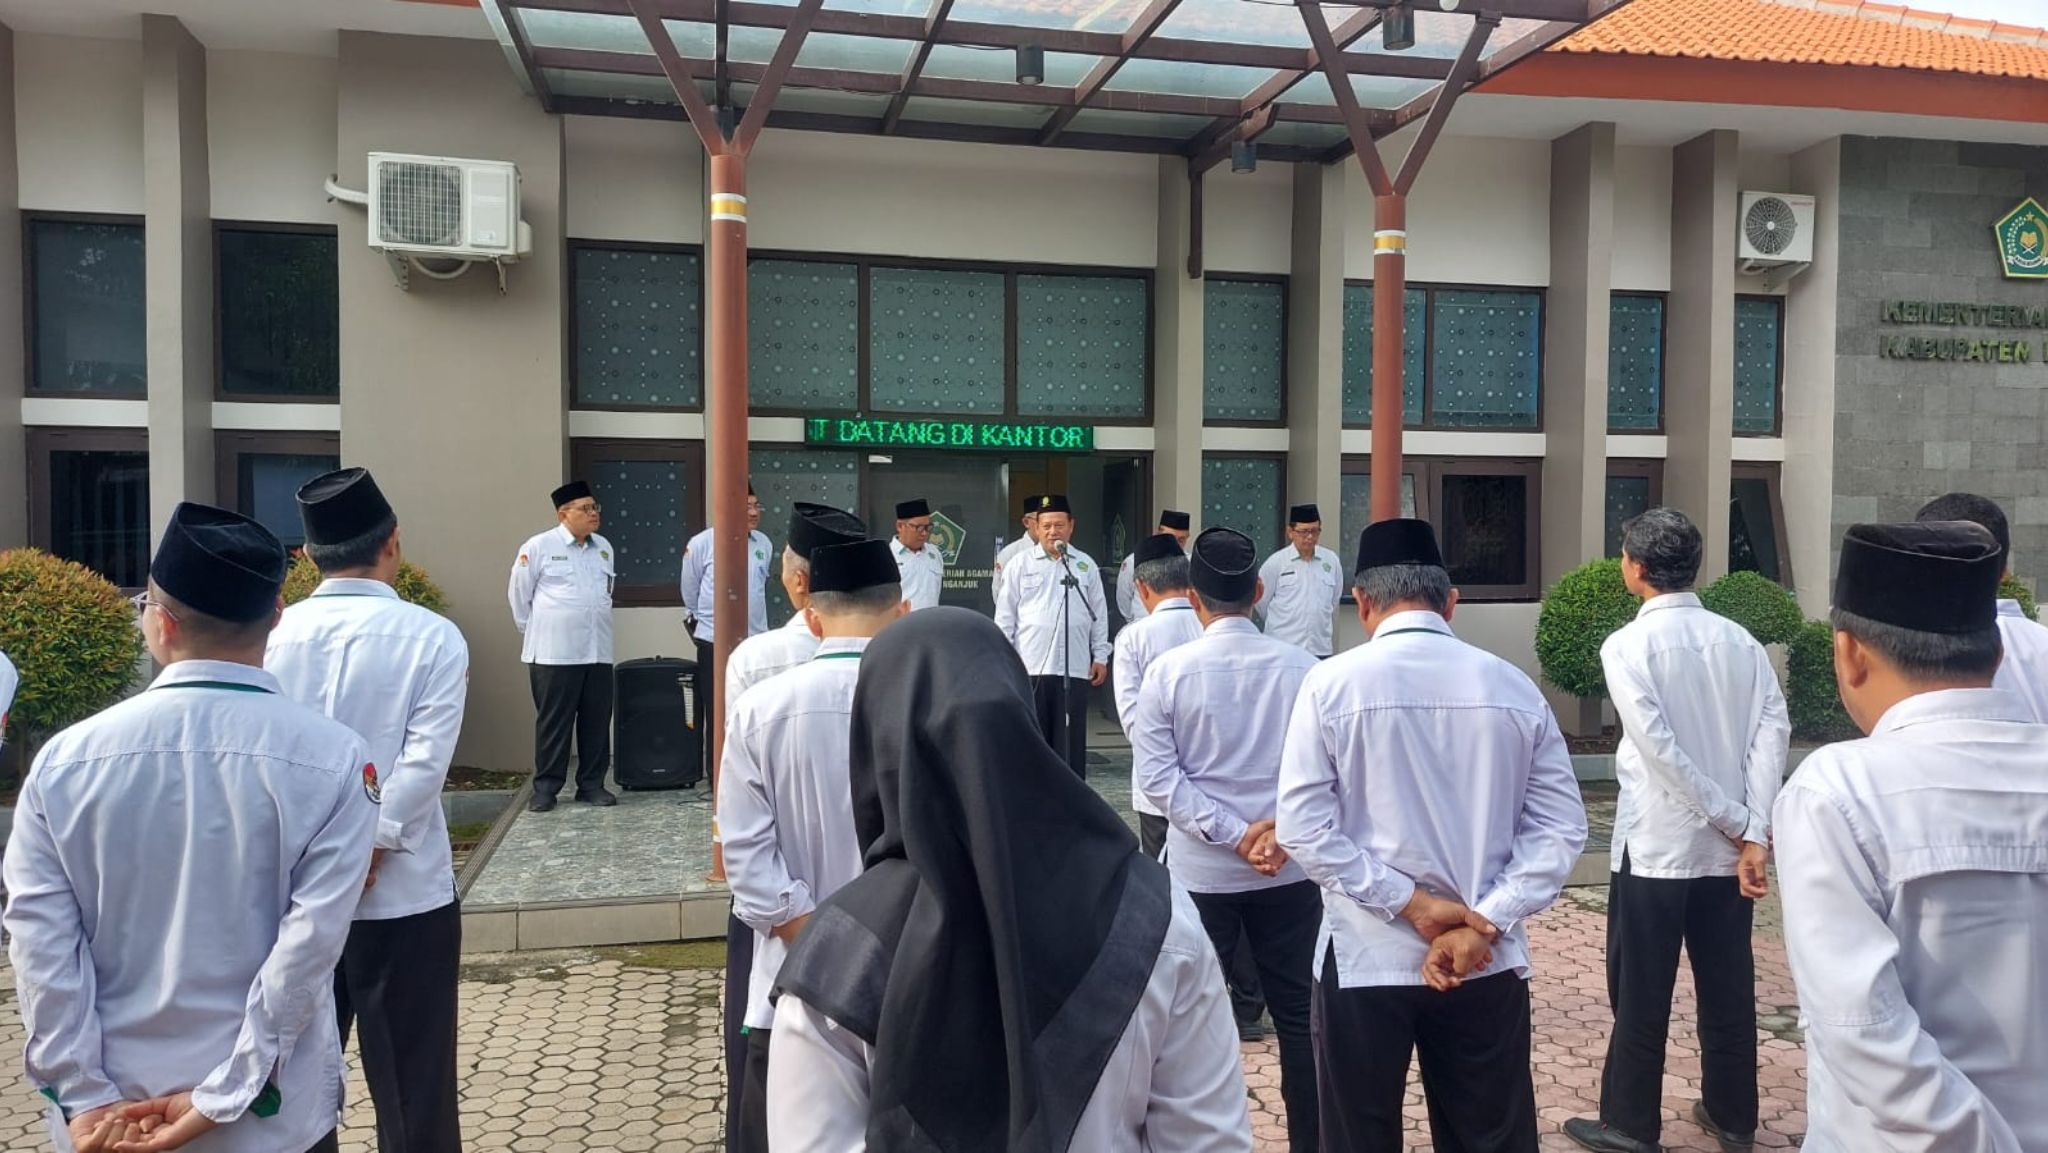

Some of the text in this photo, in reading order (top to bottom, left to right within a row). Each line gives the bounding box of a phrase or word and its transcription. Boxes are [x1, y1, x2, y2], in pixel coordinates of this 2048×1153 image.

[1879, 335, 2030, 364] KABUPATEN
[839, 420, 946, 444] DATANG
[951, 423, 974, 445] DI
[982, 424, 1085, 448] KANTOR
